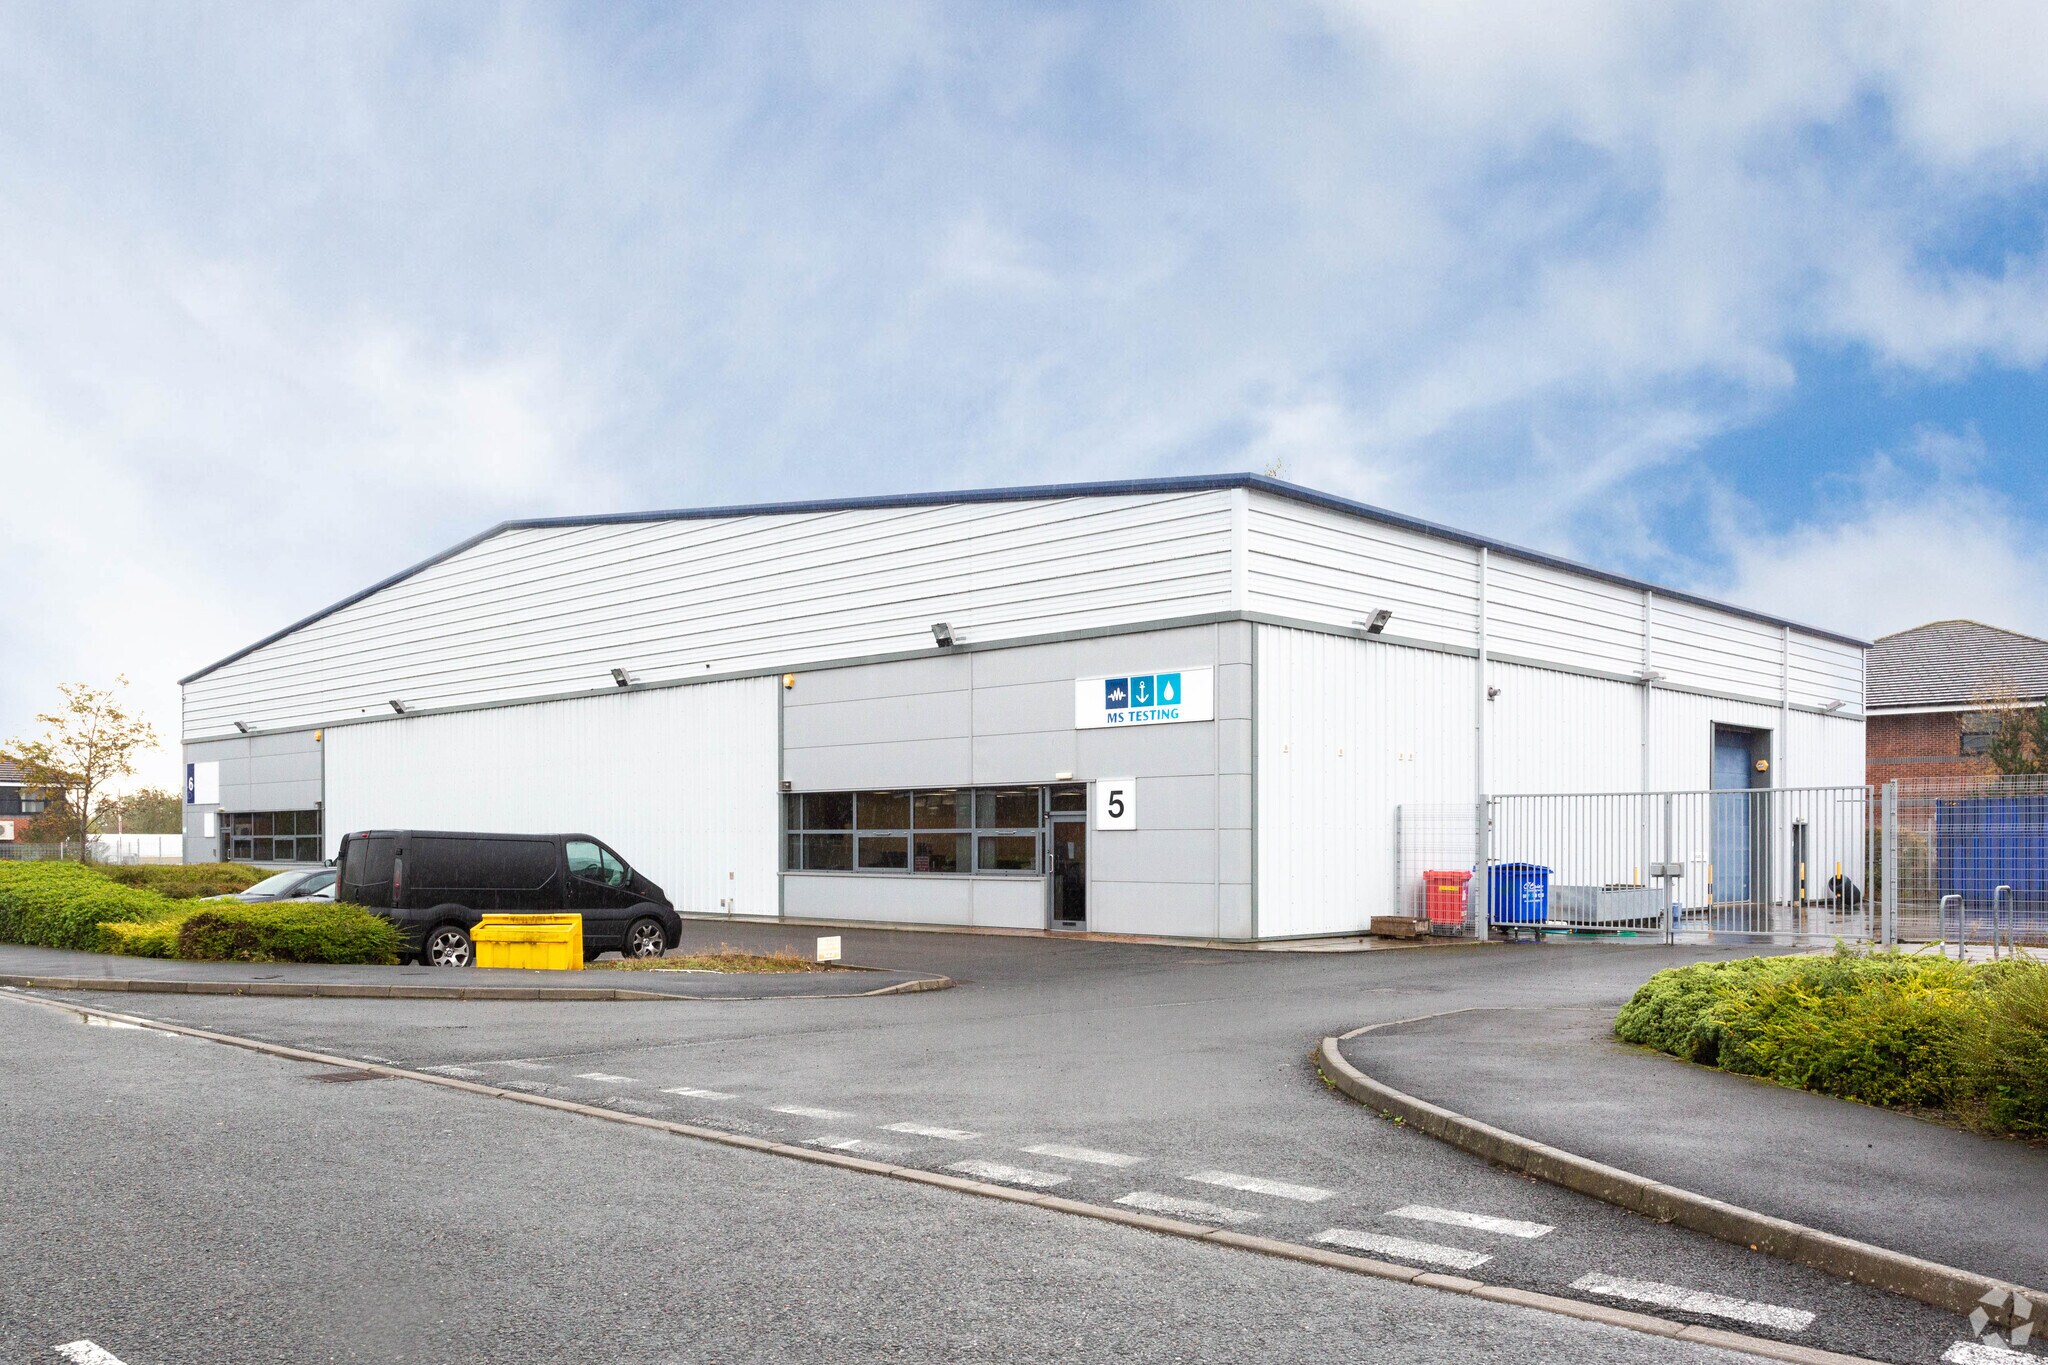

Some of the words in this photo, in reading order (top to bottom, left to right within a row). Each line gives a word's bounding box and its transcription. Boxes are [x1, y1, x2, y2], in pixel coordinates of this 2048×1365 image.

[1107, 712, 1124, 723] MS
[1128, 708, 1179, 722] TESTING
[188, 776, 194, 791] 6
[1108, 790, 1124, 818] 5
